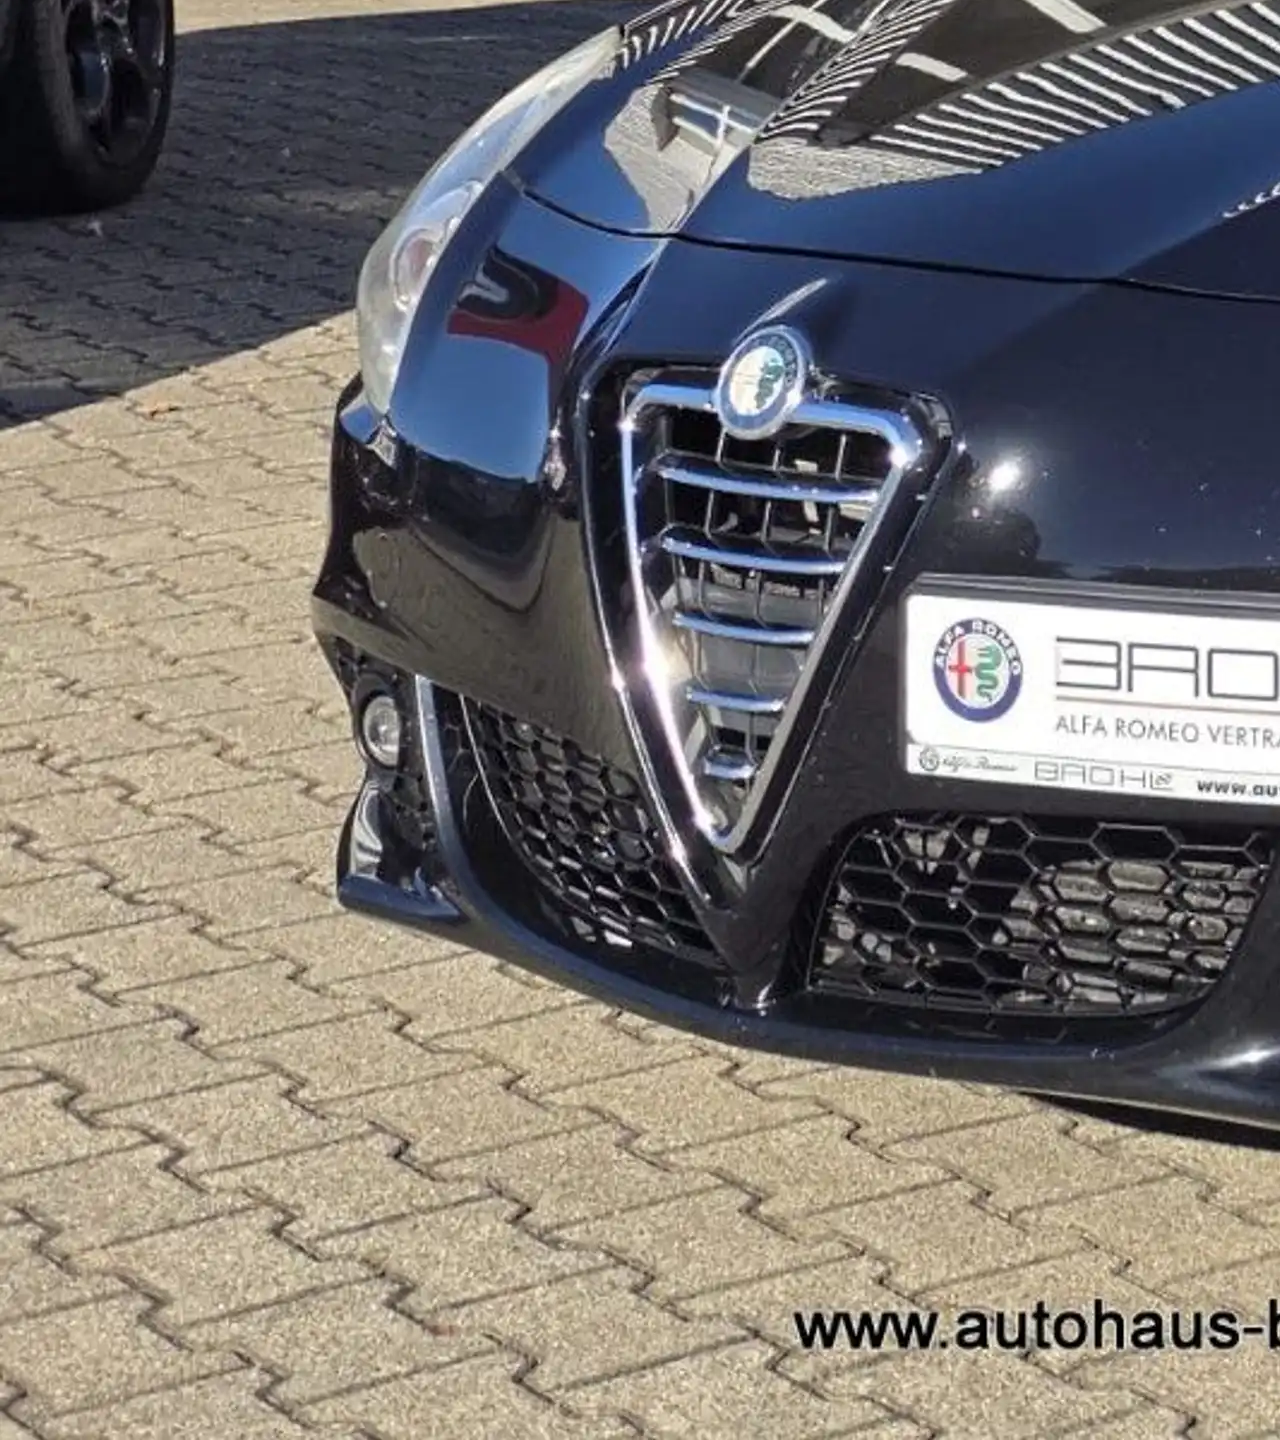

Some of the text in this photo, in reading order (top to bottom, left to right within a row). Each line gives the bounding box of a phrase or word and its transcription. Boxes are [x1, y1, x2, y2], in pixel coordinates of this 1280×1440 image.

[935, 620, 1022, 677] ALFA ROMEO
[1055, 714, 1108, 738] ALFA
[1115, 718, 1199, 744] ROMEO
